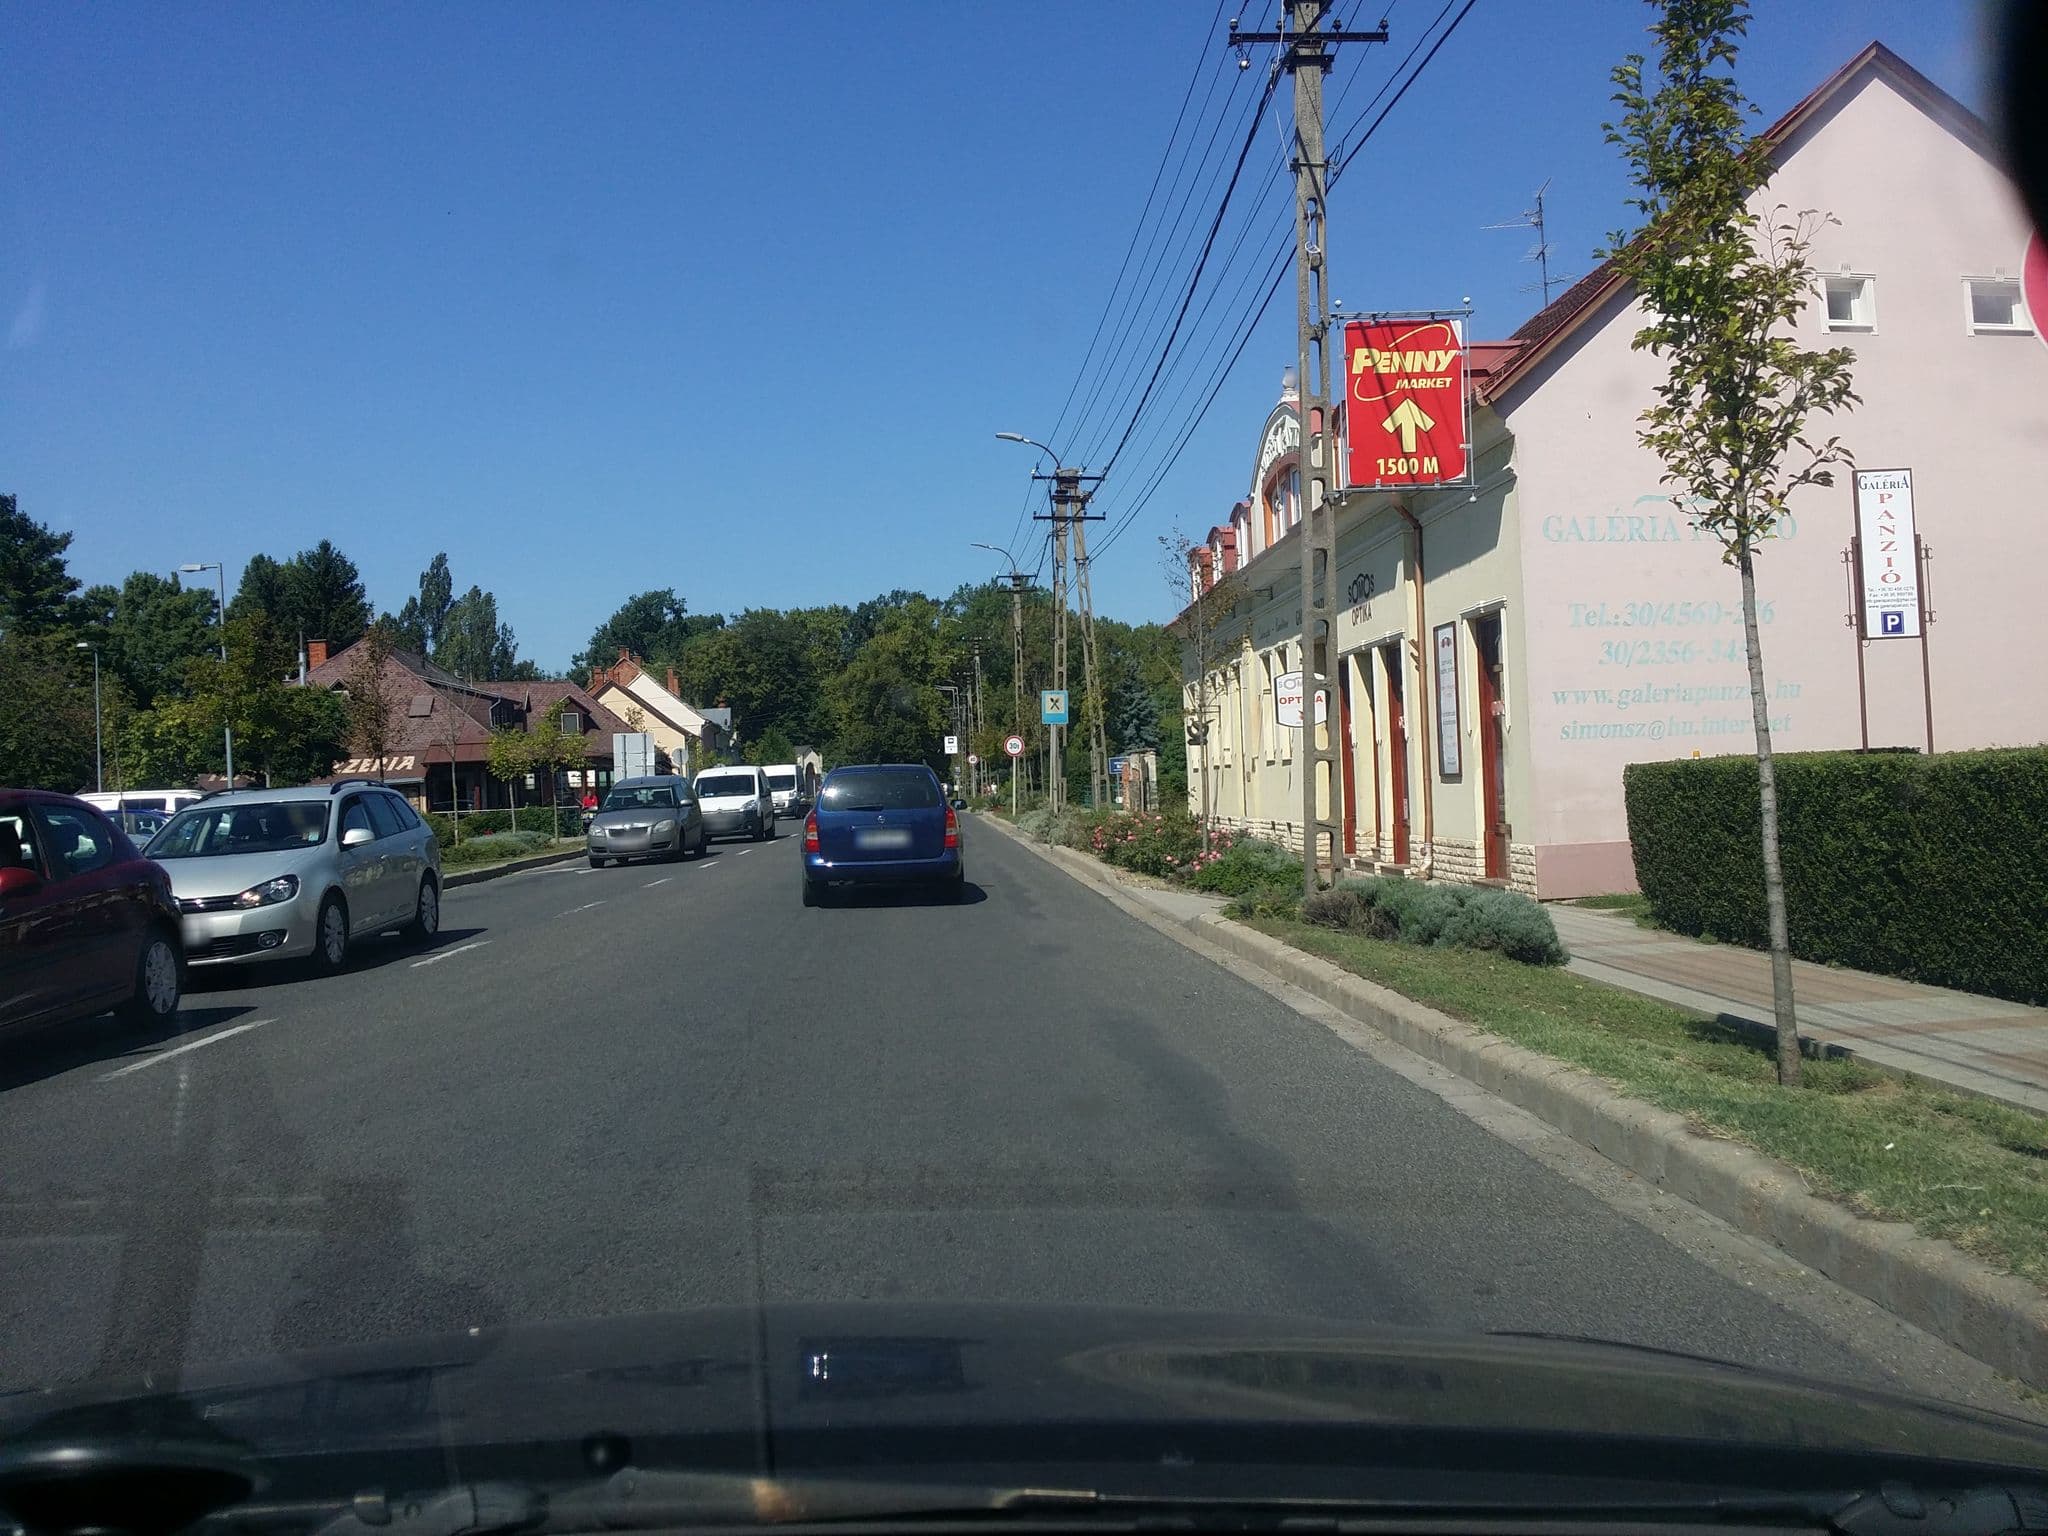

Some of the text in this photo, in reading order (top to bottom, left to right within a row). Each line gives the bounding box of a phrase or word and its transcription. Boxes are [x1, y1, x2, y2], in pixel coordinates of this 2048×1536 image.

[1352, 348, 1459, 375] PENNY
[1395, 377, 1453, 390] MARKET
[1376, 456, 1440, 476] 1500 M
[1542, 507, 1681, 543] GALÉRIA
[1351, 600, 1373, 627] OPTIKA
[1886, 617, 1902, 632] P
[1279, 695, 1324, 705] OPTA
